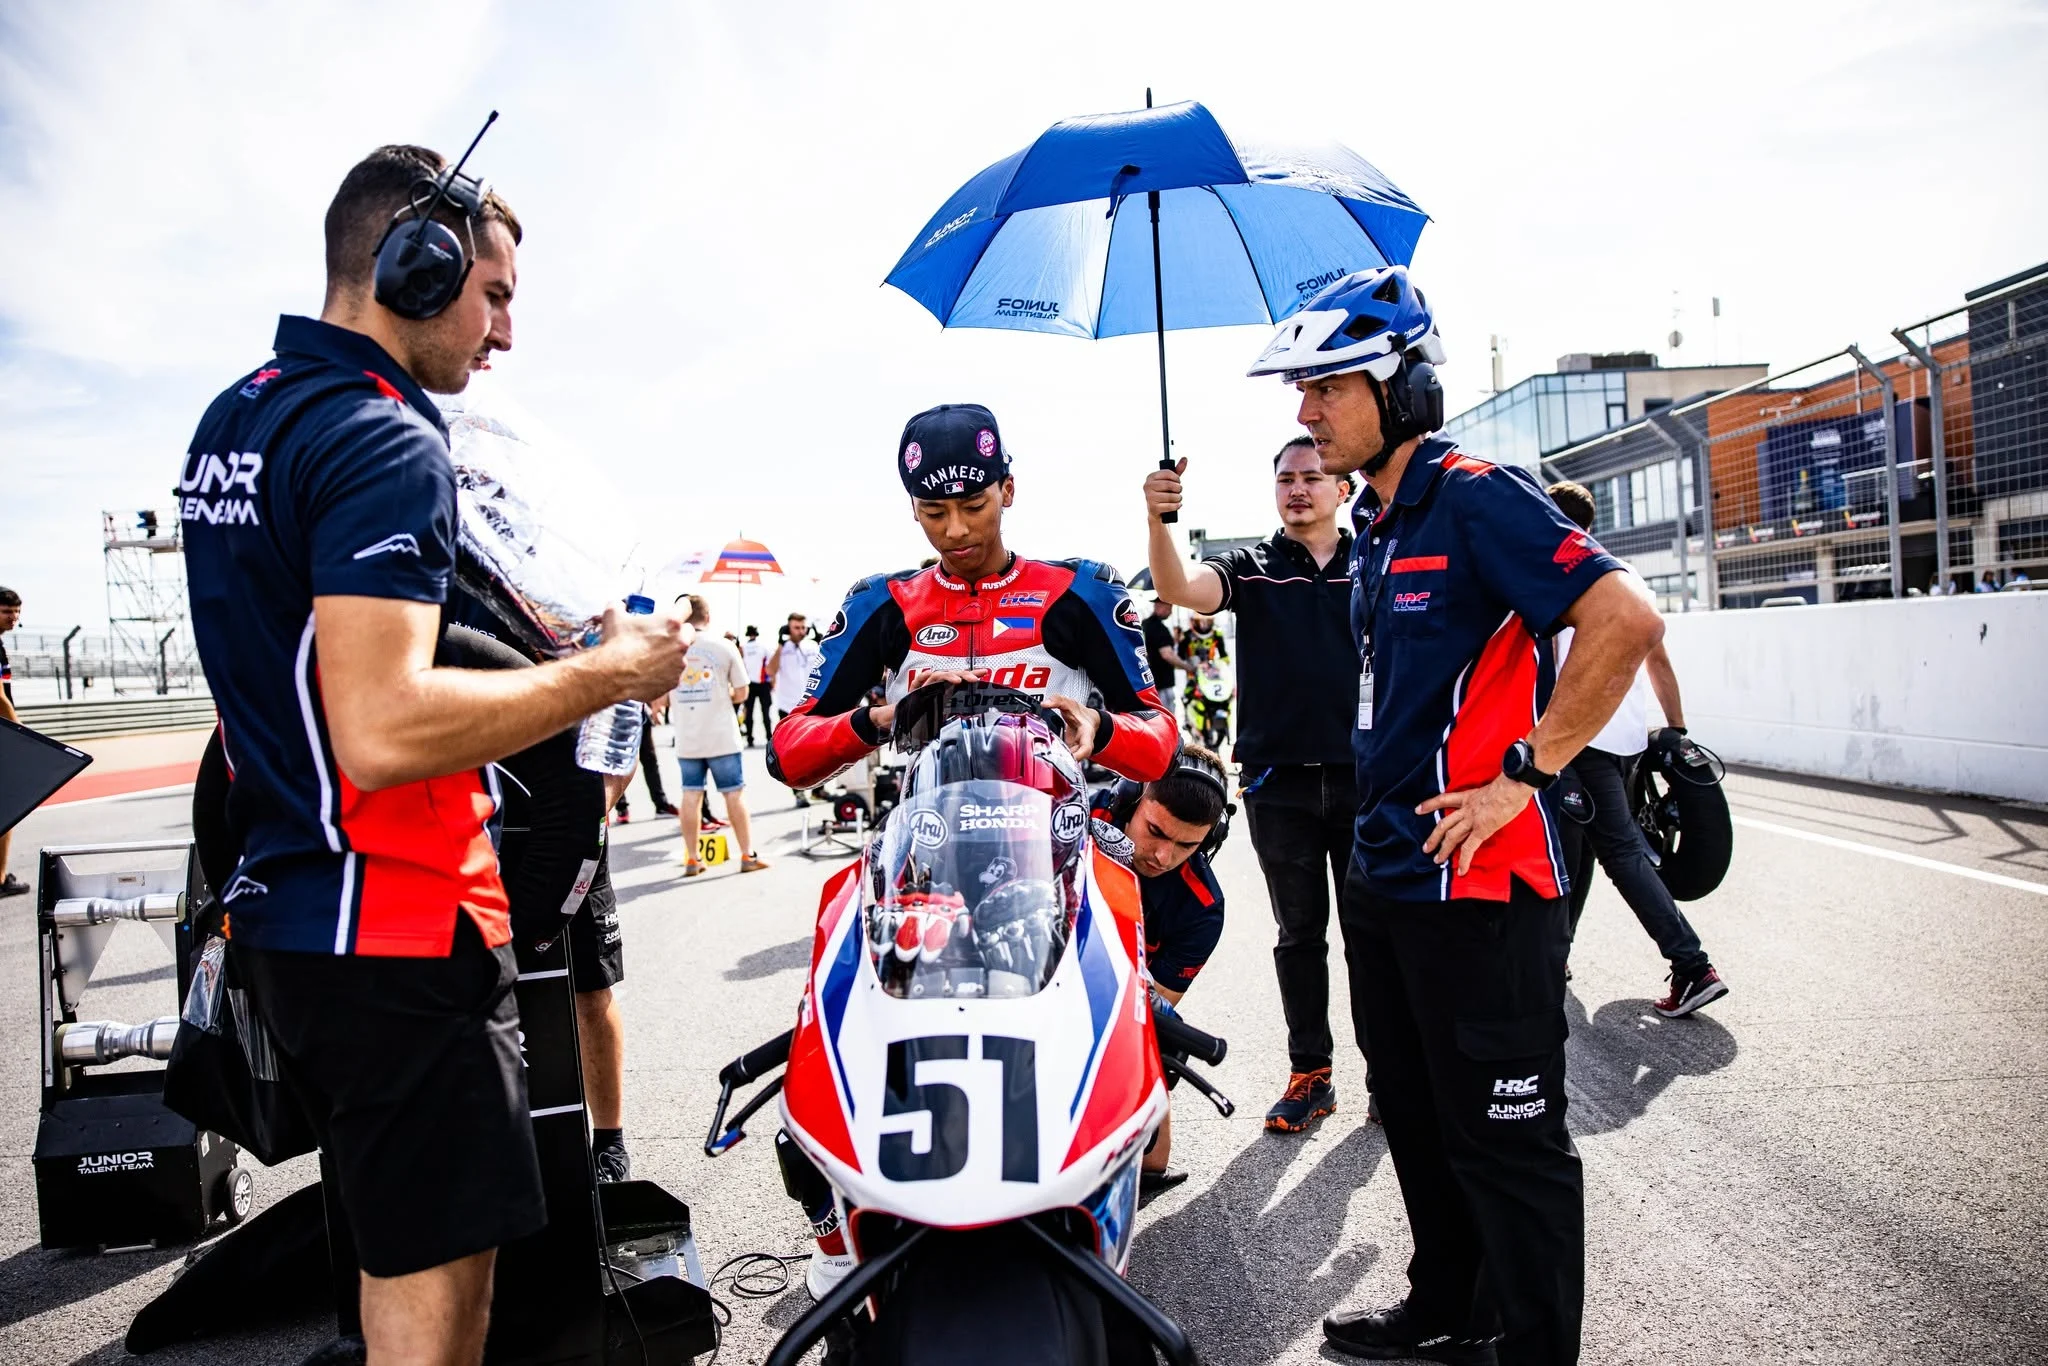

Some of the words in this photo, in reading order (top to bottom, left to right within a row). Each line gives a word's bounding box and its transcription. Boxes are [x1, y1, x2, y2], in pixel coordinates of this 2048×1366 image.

[921, 465, 985, 491] YANKEES
[1000, 592, 1045, 604] HRC
[1394, 592, 1431, 608] HRC
[919, 628, 952, 642] Arai
[1212, 683, 1222, 697] 2
[959, 804, 1040, 817] SHARP
[911, 813, 943, 839] Arai
[959, 818, 1041, 832] HONDA
[1057, 808, 1085, 833] Arai
[1493, 1074, 1539, 1093] HRC
[878, 1034, 1039, 1184] 51
[1487, 1098, 1546, 1114] JUNIOR
[1487, 1112, 1522, 1120] TALENT
[1522, 1106, 1546, 1119] TEAM
[78, 1151, 153, 1168] JUNIOR
[77, 1164, 119, 1175] TALENT
[120, 1161, 155, 1171] TEAM
